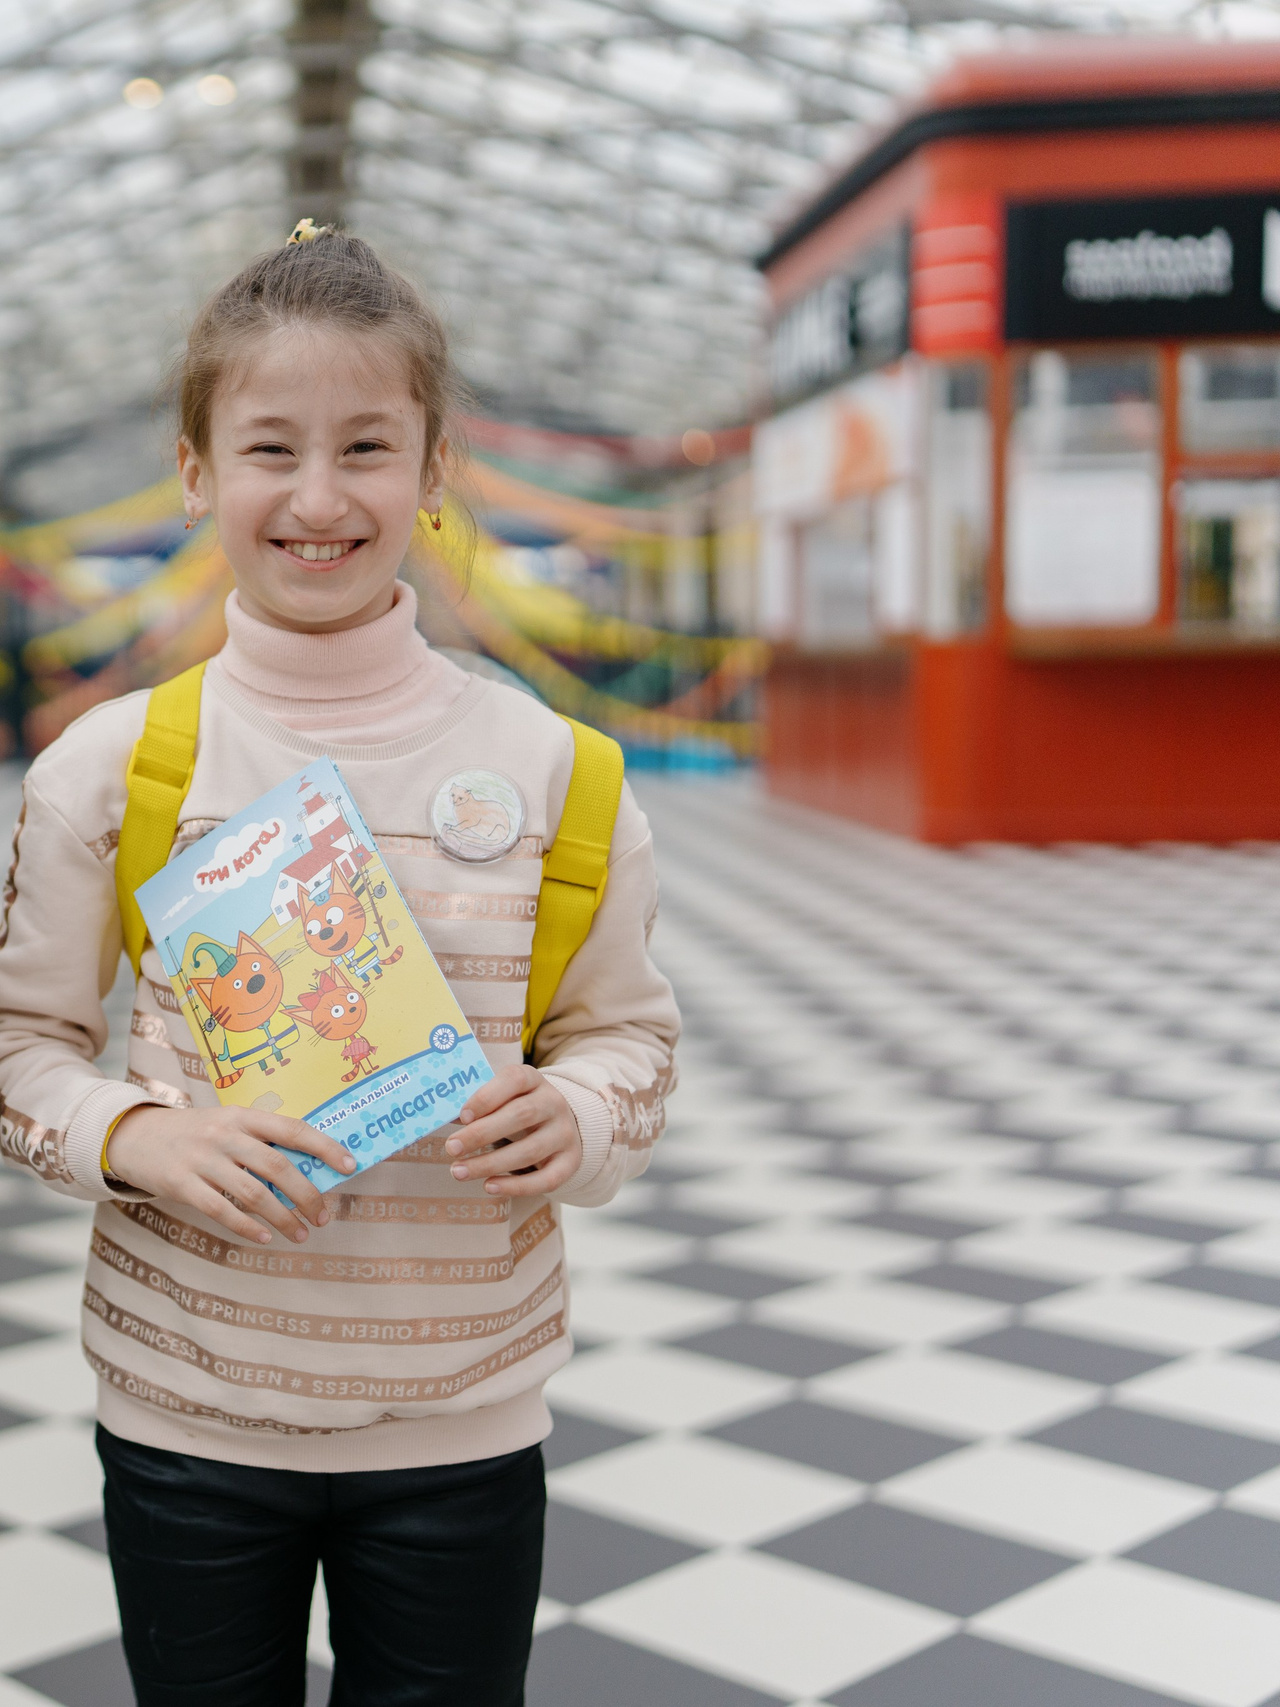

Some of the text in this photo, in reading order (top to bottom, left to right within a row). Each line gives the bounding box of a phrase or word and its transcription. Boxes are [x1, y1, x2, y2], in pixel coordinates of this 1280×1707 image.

[197, 865, 230, 885] ТРИ
[314, 1073, 410, 1131] АЗКИ-МАЛЫШКИ
[365, 1065, 480, 1139] спасатели
[349, 1201, 418, 1218] QUEEN
[138, 1207, 207, 1252] PRINCESS
[226, 1250, 294, 1272] QUEEN
[323, 1261, 425, 1279] PRINCESS
[449, 1262, 509, 1279] QUEEN
[149, 1271, 192, 1308] QUEEN
[211, 1302, 311, 1335] PRINCESS
[341, 1323, 413, 1340] QUEEN
[439, 1309, 519, 1338] PRINCESS
[122, 1316, 198, 1360] PRINCESS
[213, 1361, 282, 1386] QUEEN
[500, 1320, 558, 1366] PRINCESS
[125, 1378, 181, 1411] QUEEN
[312, 1379, 419, 1398] PRINCESS
[440, 1364, 486, 1395] QUEEN
